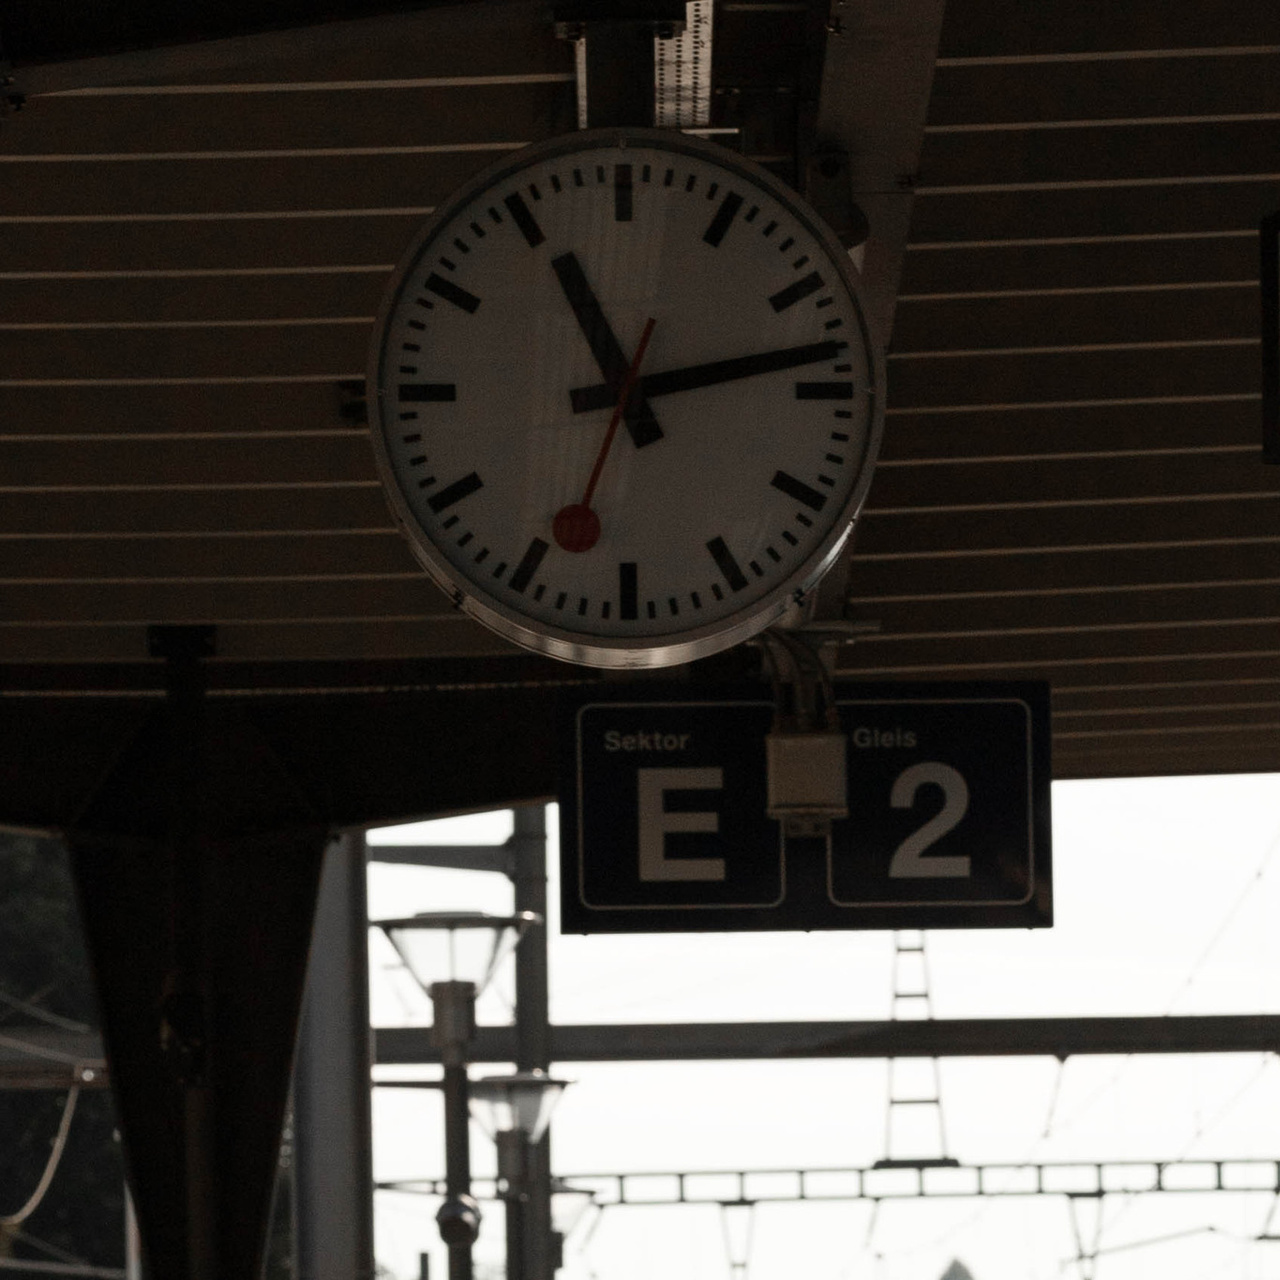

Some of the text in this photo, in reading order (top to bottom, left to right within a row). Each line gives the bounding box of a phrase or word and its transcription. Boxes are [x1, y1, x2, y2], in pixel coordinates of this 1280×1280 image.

[605, 730, 690, 752] Sektor
[852, 726, 918, 749] Gleis
[638, 767, 726, 882] E
[888, 762, 972, 879] 2
